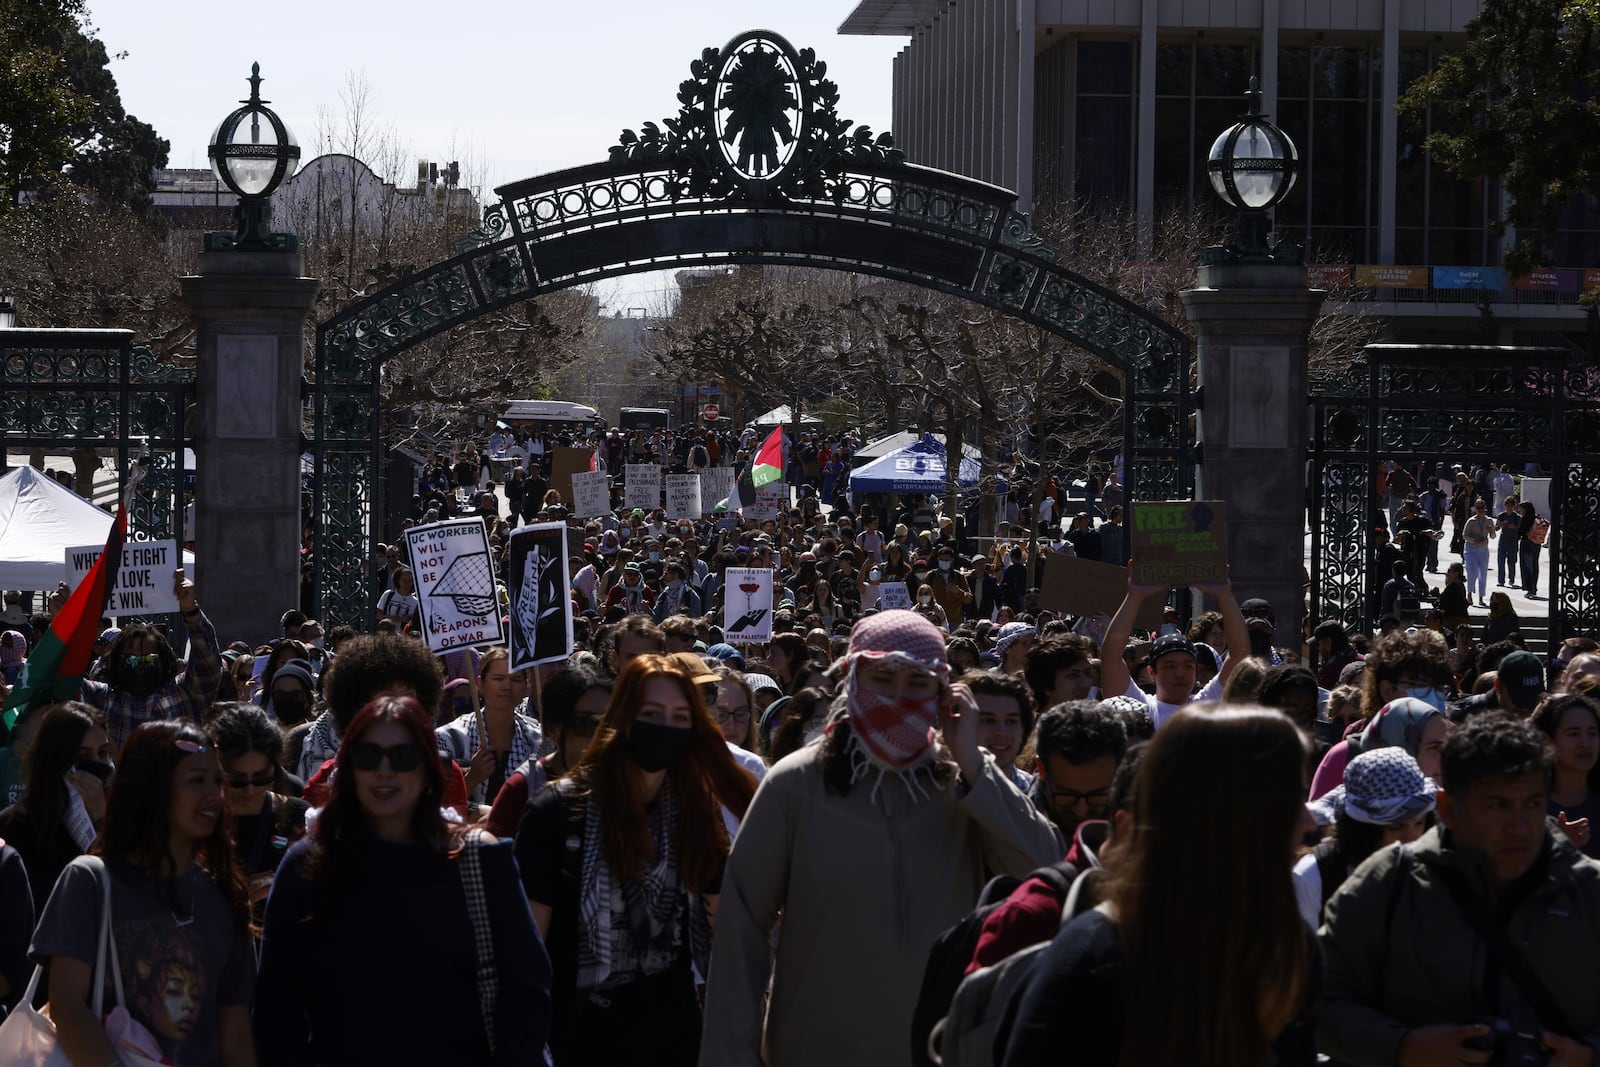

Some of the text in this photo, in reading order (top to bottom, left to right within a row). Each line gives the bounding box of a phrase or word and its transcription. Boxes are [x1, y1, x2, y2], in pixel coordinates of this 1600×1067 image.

[1134, 505, 1188, 532] FREE
[412, 525, 481, 545] UC WORKERS
[119, 549, 130, 567] E
[133, 547, 167, 566] FIGHT
[417, 542, 447, 554] WILL
[420, 556, 445, 570] NOT
[122, 569, 155, 589] LOVE,
[422, 571, 437, 584] BE
[517, 575, 531, 623] FREE
[431, 616, 488, 635] WEAPONS
[441, 631, 484, 648] OF WAR
